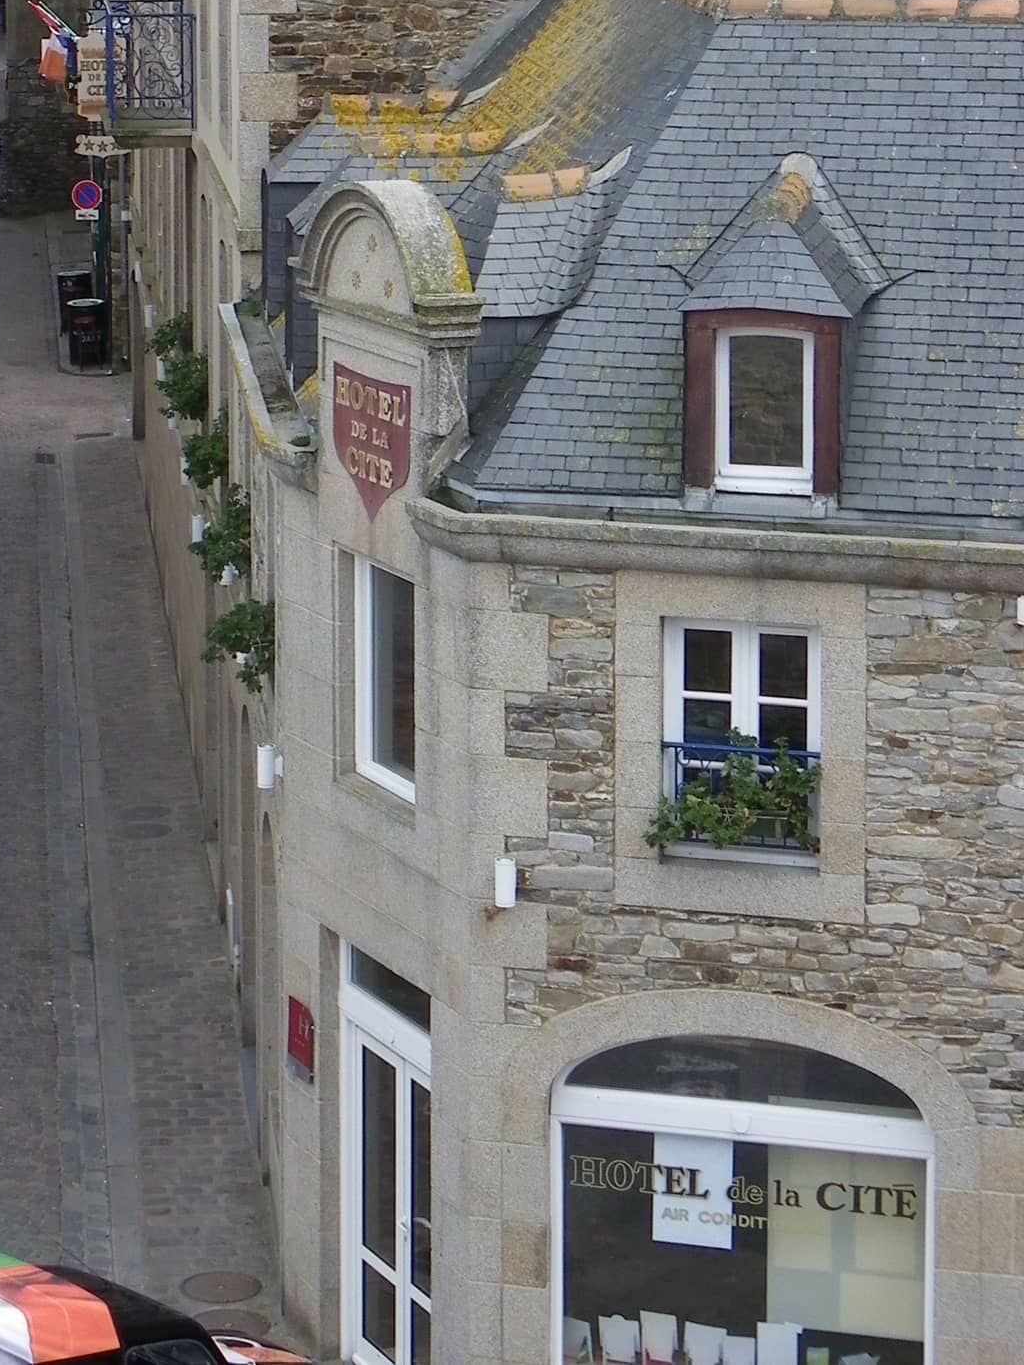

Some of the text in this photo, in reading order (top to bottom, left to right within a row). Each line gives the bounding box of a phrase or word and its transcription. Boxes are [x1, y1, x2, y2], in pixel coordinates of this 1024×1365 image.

[335, 375, 406, 427] HOTEL
[351, 419, 389, 449] DE LA
[345, 445, 393, 489] CITE
[570, 1154, 710, 1199] HOTEL
[726, 1177, 764, 1206] de
[773, 1179, 803, 1209] la
[661, 1207, 689, 1222] AIR
